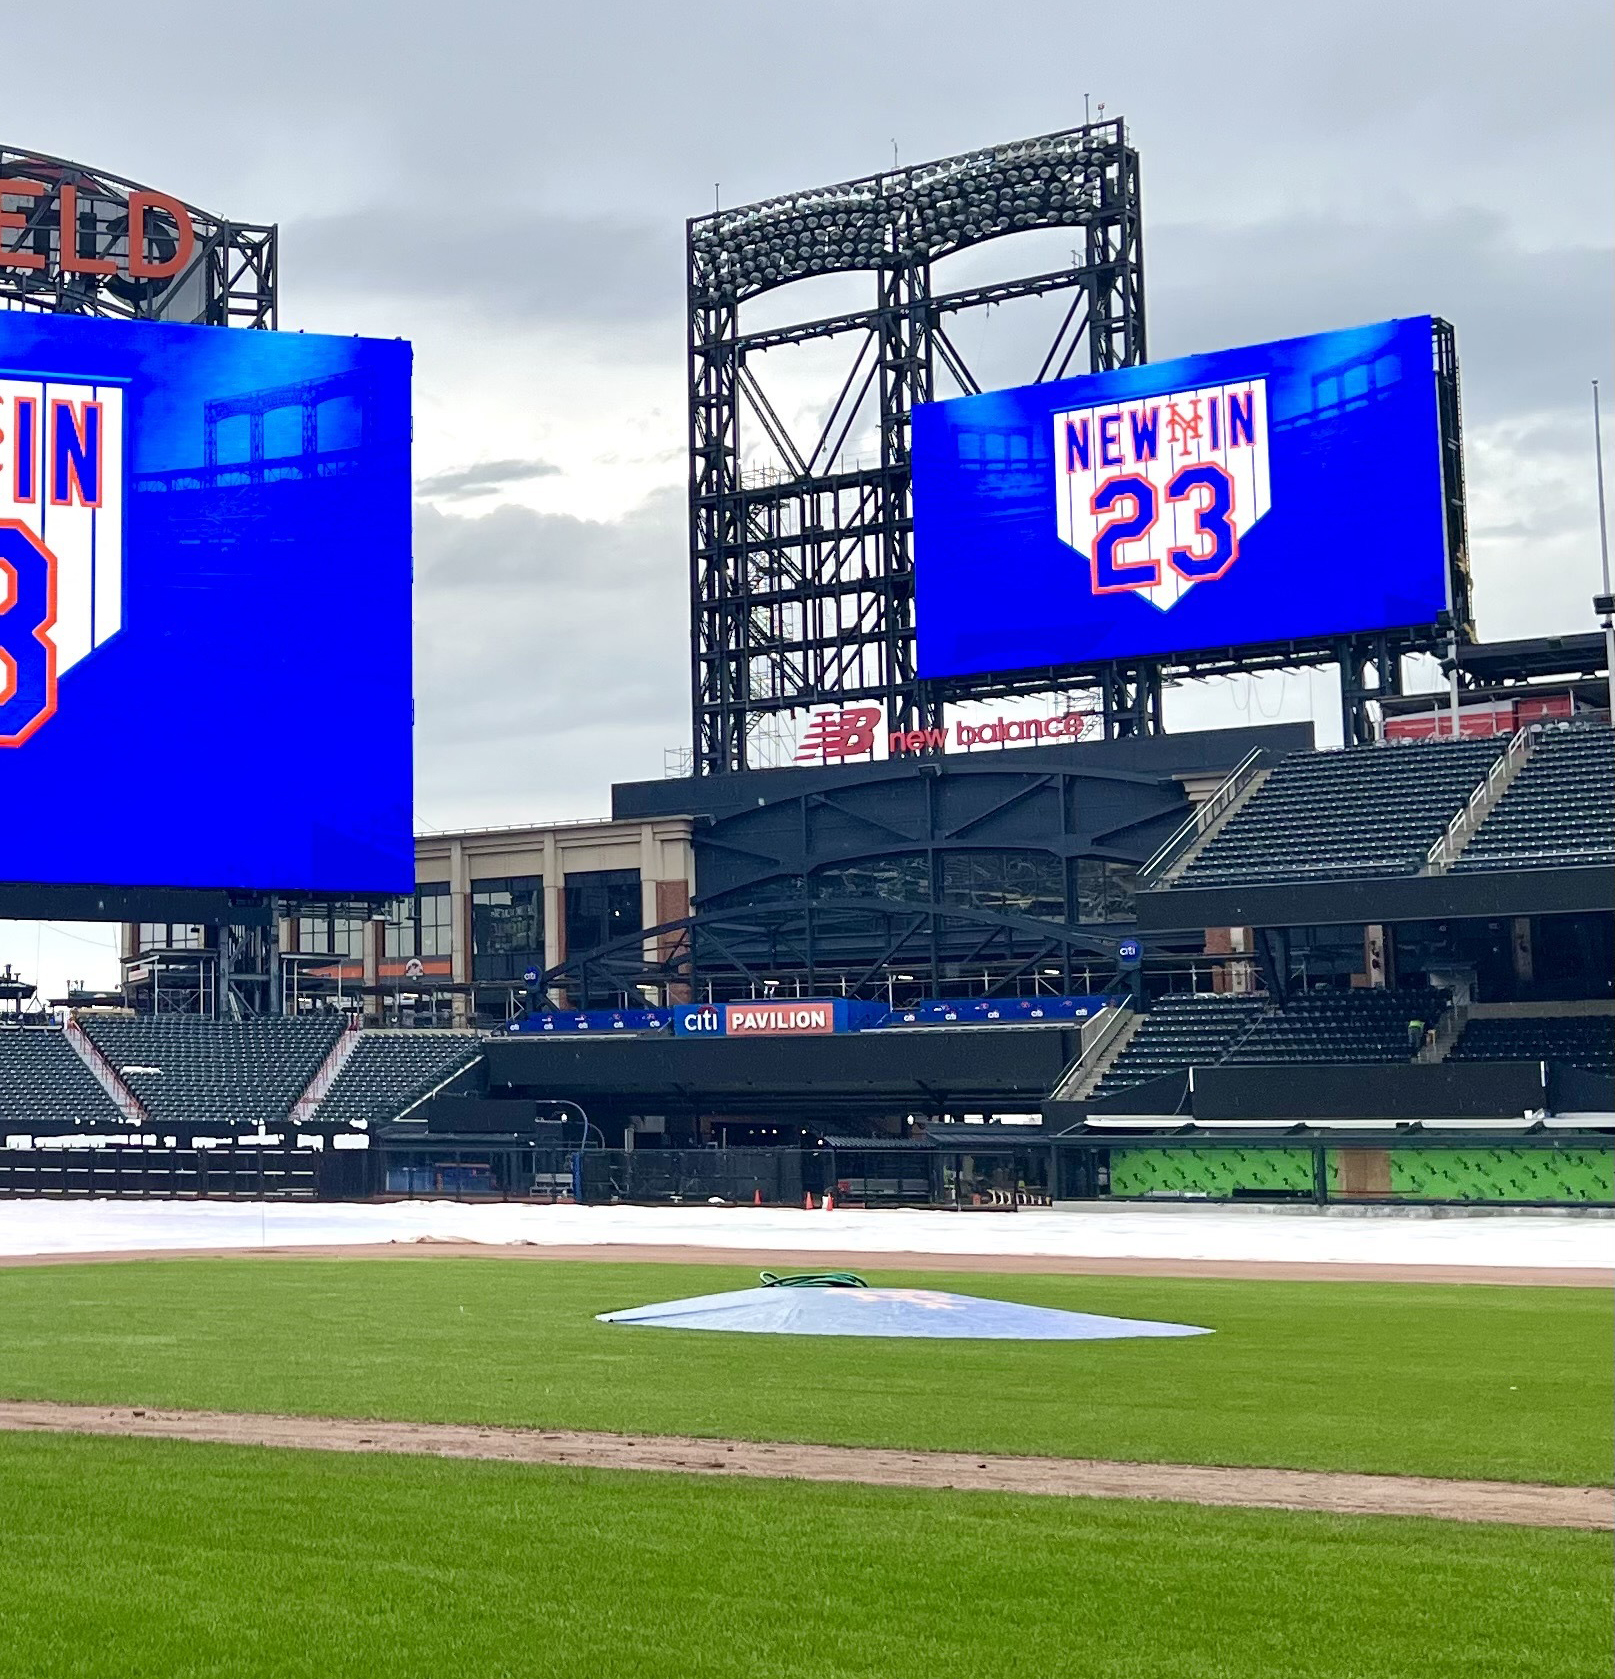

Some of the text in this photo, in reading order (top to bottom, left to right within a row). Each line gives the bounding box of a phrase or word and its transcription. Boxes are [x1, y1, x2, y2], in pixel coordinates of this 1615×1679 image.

[13, 396, 103, 508] IN
[1064, 404, 1161, 474] NEW
[1208, 389, 1257, 452] IN
[1089, 461, 1240, 595] 23
[889, 714, 1085, 753] new balance
[684, 1009, 826, 1031] citi PAVILION
